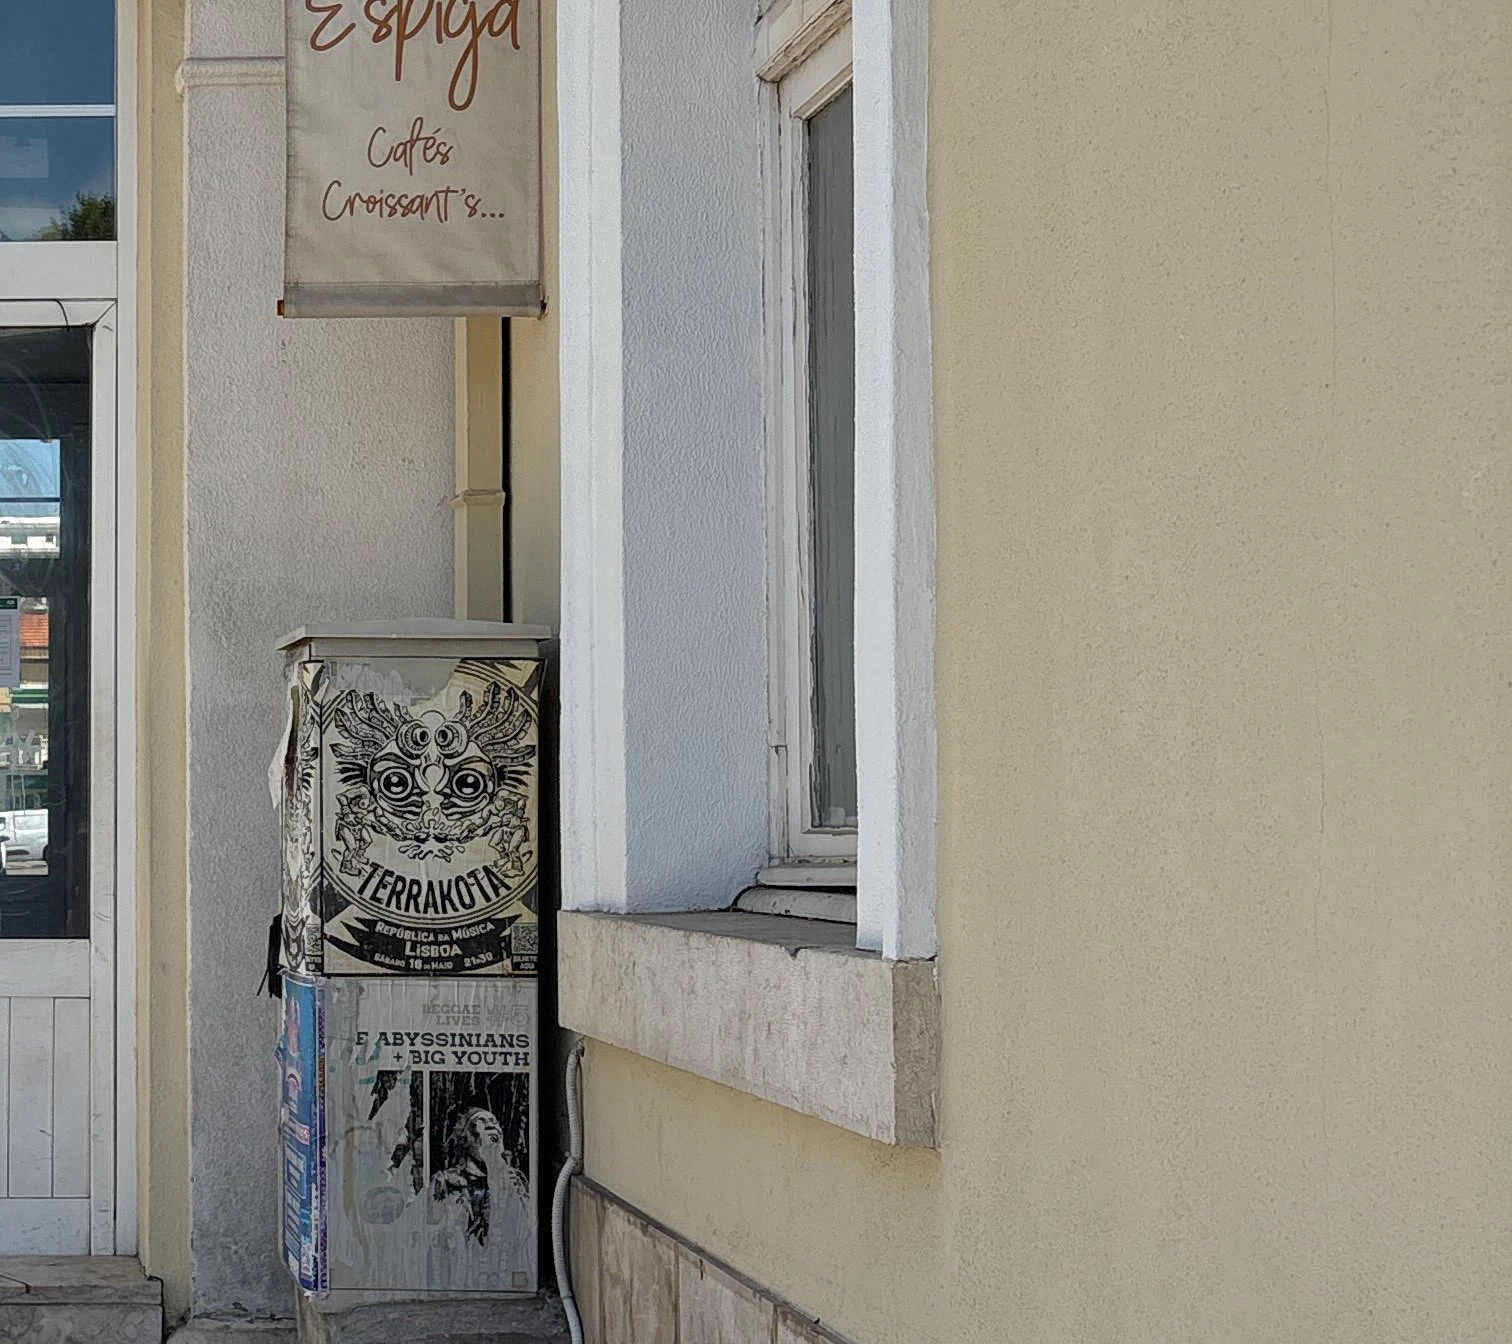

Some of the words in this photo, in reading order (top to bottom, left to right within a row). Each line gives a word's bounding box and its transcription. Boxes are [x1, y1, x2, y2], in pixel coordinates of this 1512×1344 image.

[367, 116, 453, 177] Cafés
[357, 860, 512, 915] TERRAKOTA
[375, 1031, 530, 1048] ABYSSINIANS
[409, 1050, 446, 1065] BIG
[451, 1050, 530, 1067] YOUTH
